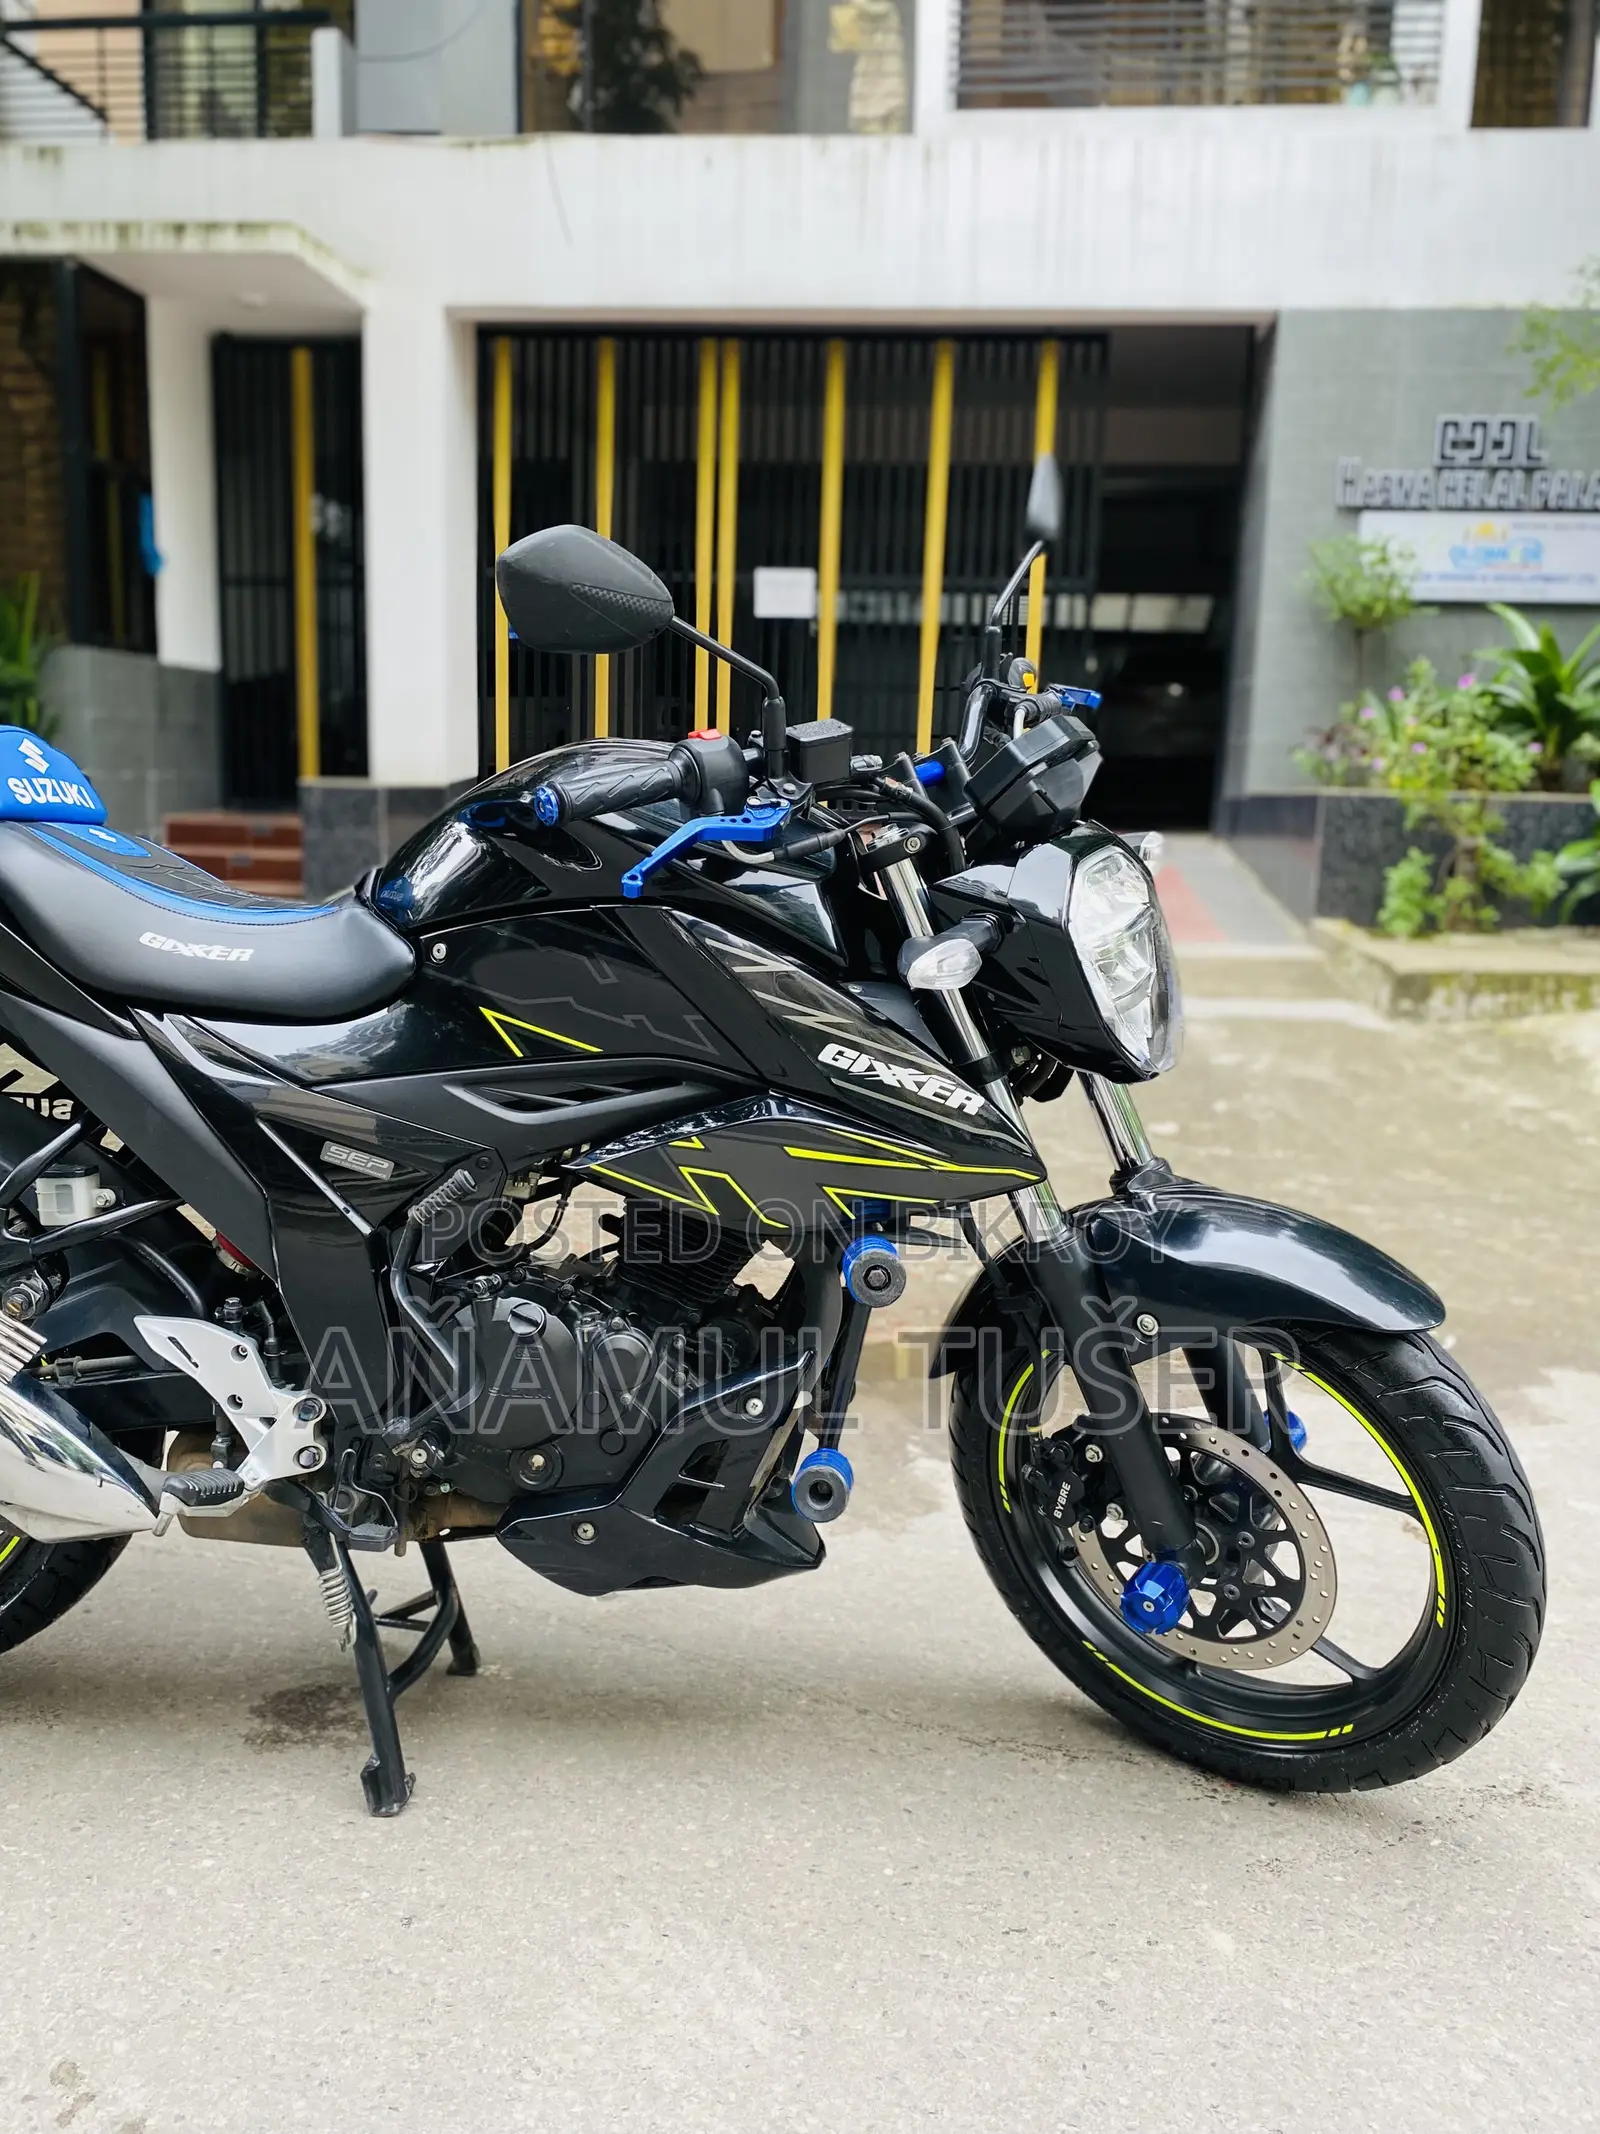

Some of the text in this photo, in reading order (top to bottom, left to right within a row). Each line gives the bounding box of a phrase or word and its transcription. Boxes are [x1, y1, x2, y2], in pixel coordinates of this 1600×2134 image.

[7, 777, 96, 810] SUZUKI
[139, 931, 255, 963] GIXXER
[817, 1042, 988, 1117] GIXXER
[326, 1145, 389, 1169] SEP
[1053, 1481, 1071, 1519] BYBRE
